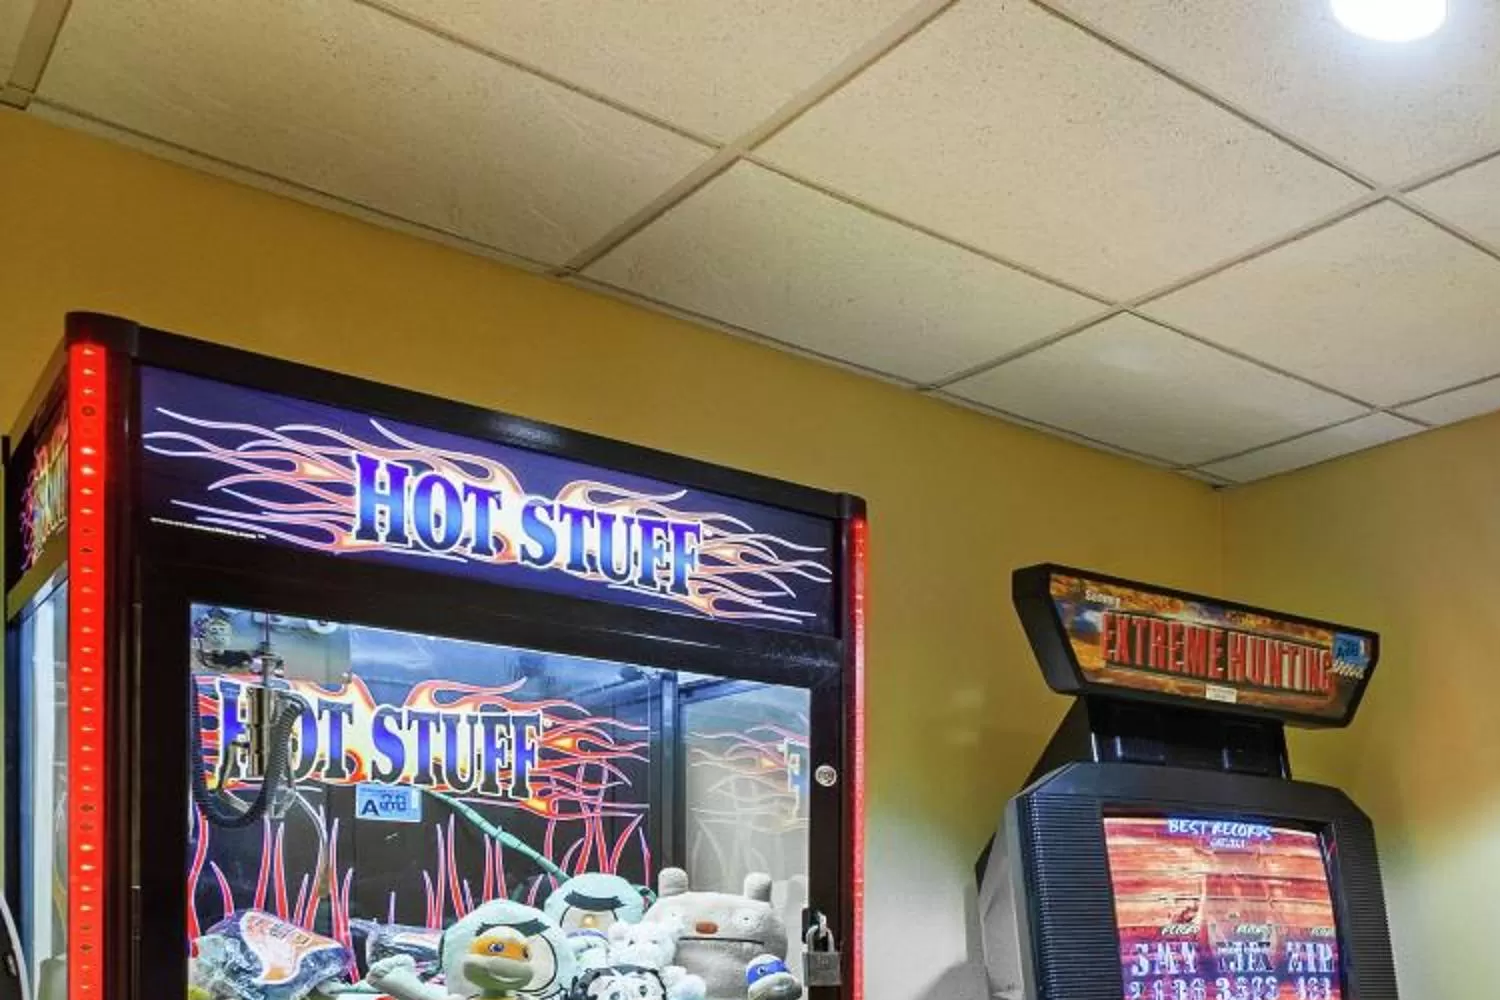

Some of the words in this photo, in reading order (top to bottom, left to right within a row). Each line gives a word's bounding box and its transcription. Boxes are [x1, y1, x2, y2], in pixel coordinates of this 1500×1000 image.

[353, 453, 502, 556] HOT
[520, 501, 702, 596] STUFF
[1102, 611, 1226, 680] EXTREME
[1227, 630, 1334, 697] HUNTING
[371, 703, 543, 798] STUFF
[361, 799, 379, 816] A
[1168, 818, 1208, 836] BEST
[1211, 820, 1272, 841] RECORDS
